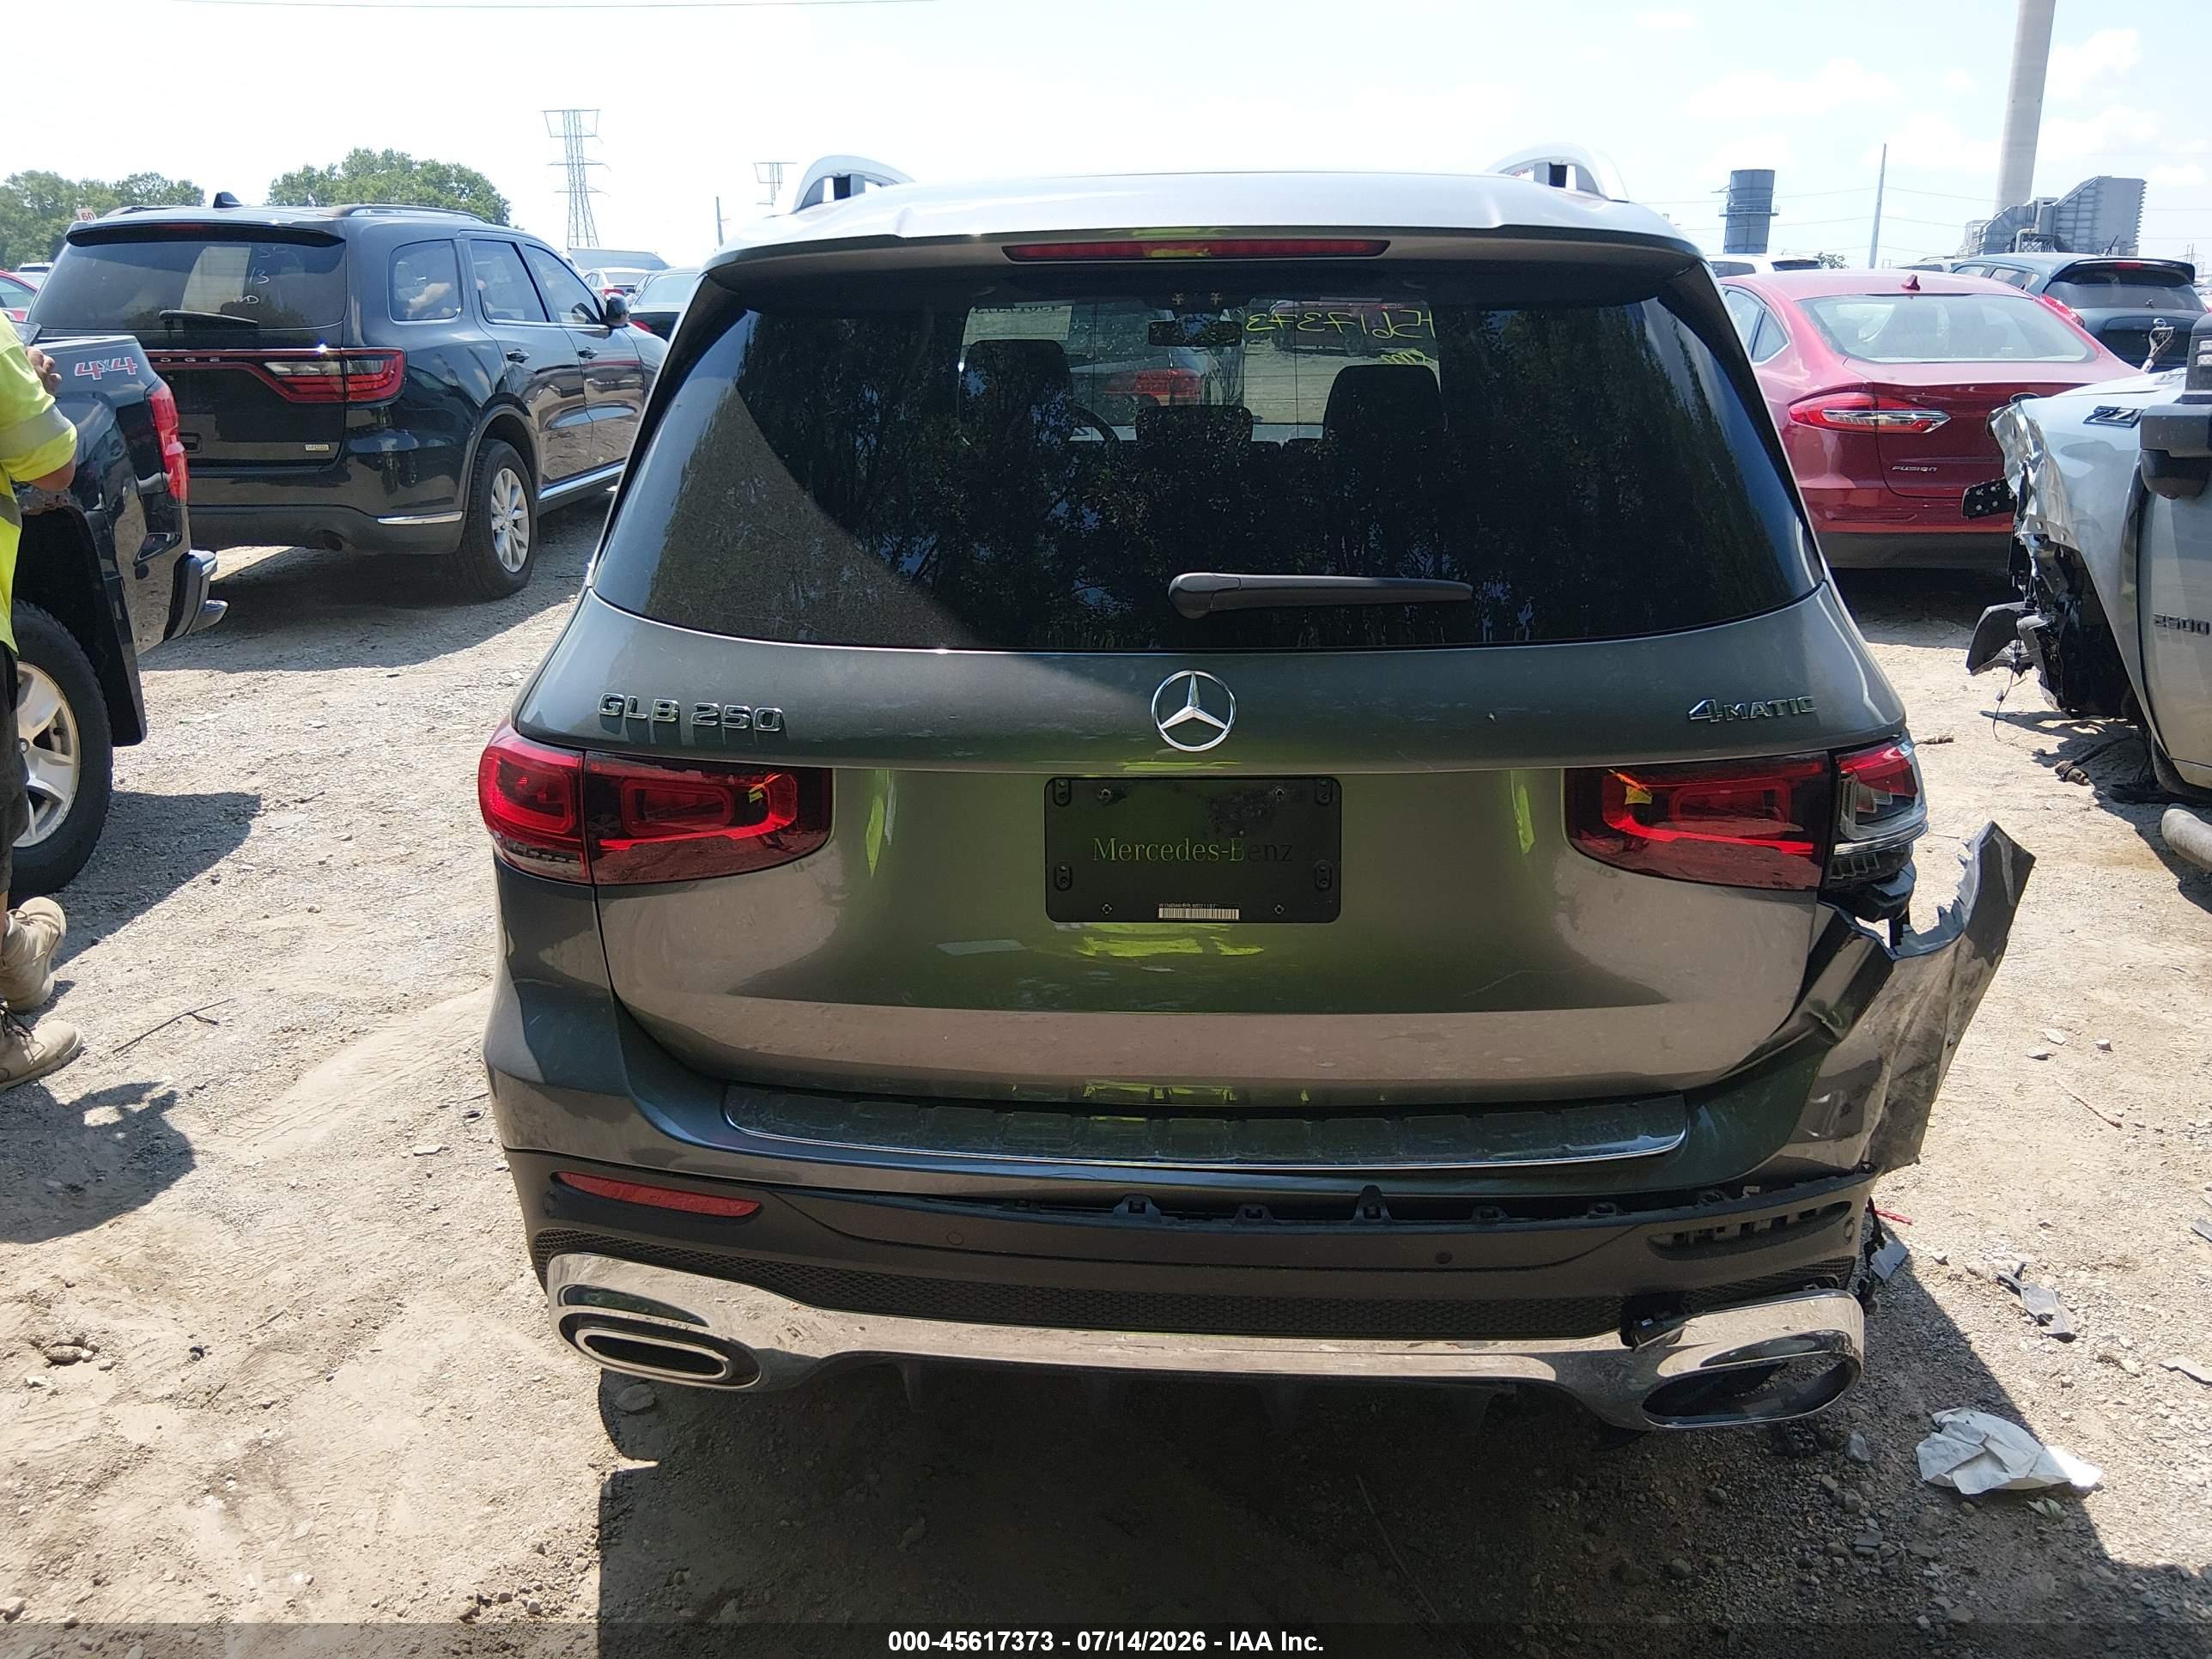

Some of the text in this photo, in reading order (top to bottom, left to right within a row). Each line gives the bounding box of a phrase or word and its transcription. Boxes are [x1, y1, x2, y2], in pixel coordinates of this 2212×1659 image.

[2153, 612, 2209, 635] 2500
[598, 692, 783, 732] GLB 250
[1688, 696, 1818, 723] 4MATIC
[1091, 836, 1294, 862] Mercedes-Benz
